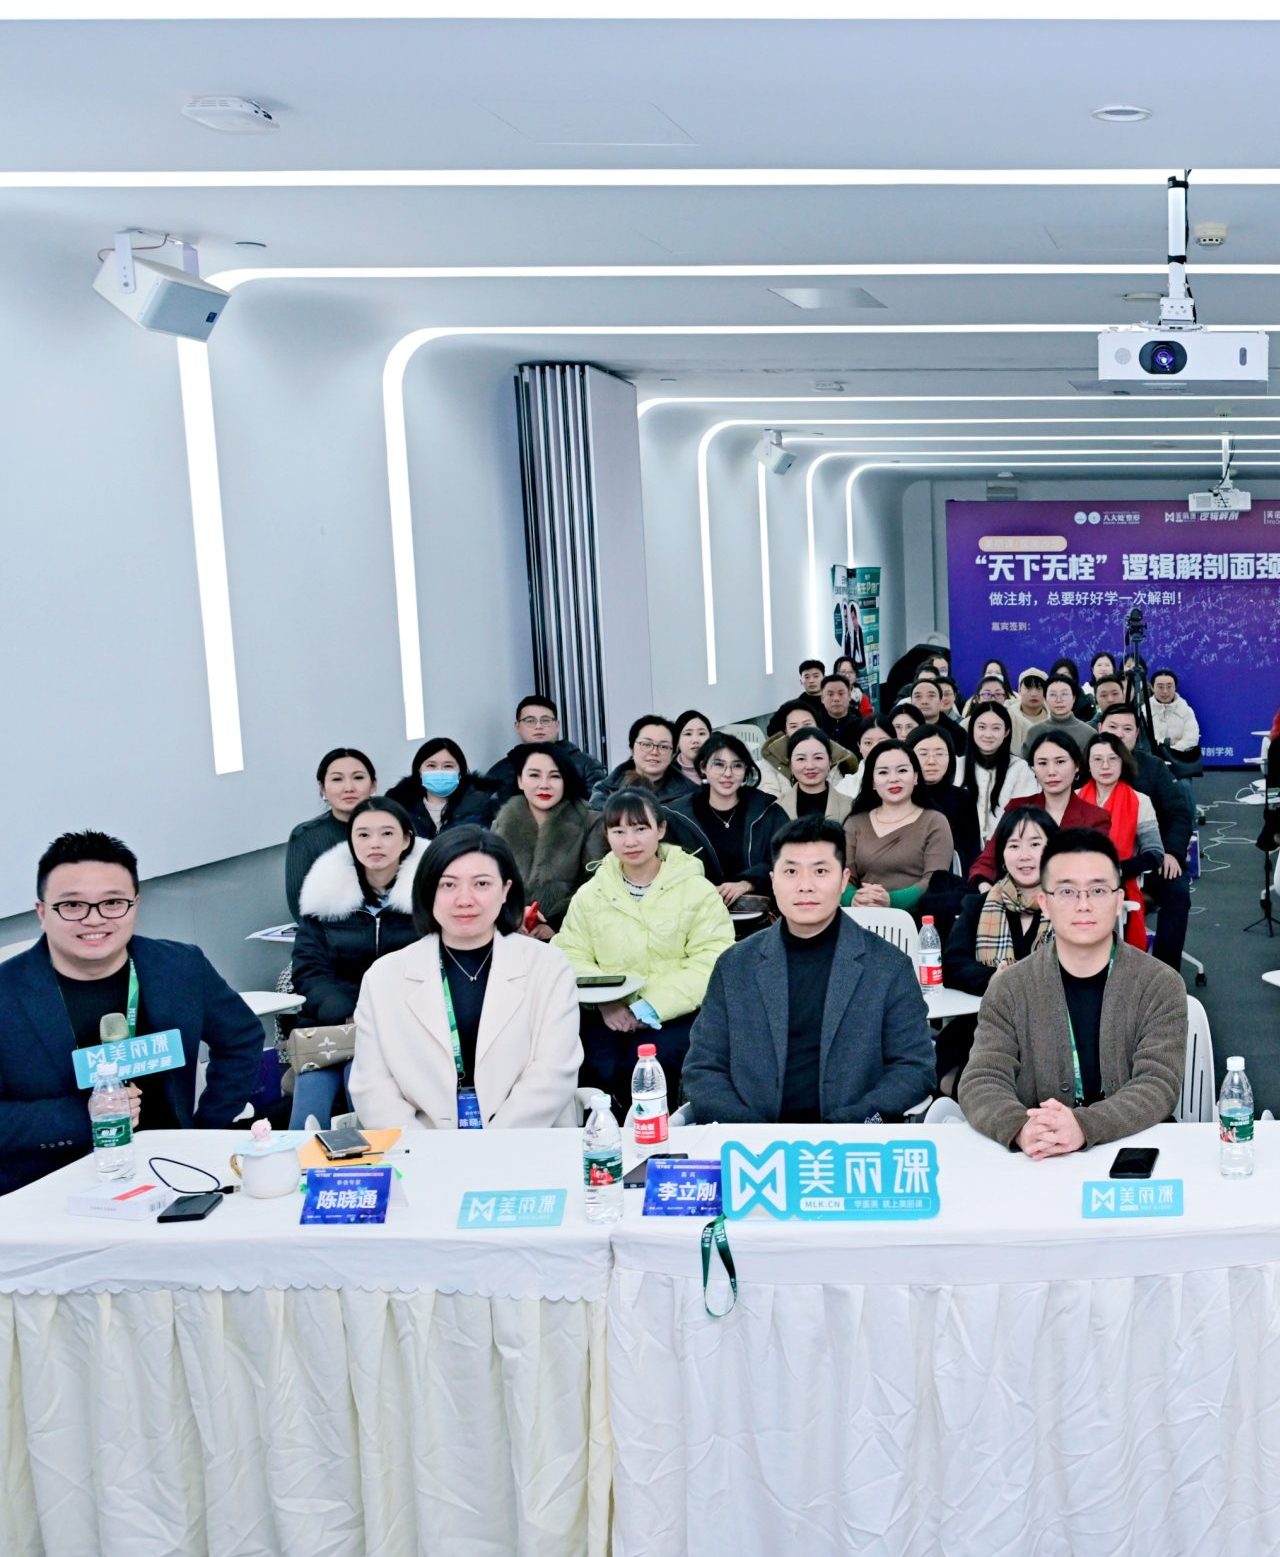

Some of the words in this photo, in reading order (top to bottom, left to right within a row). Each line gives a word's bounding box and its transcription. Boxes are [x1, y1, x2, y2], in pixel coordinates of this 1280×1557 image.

[110, 1034, 169, 1061] 美丽课
[798, 1148, 931, 1194] 美丽课
[316, 1189, 378, 1210] 陈晓通
[657, 1181, 718, 1201] 李立刚
[804, 1200, 841, 1209] MLK.CN
